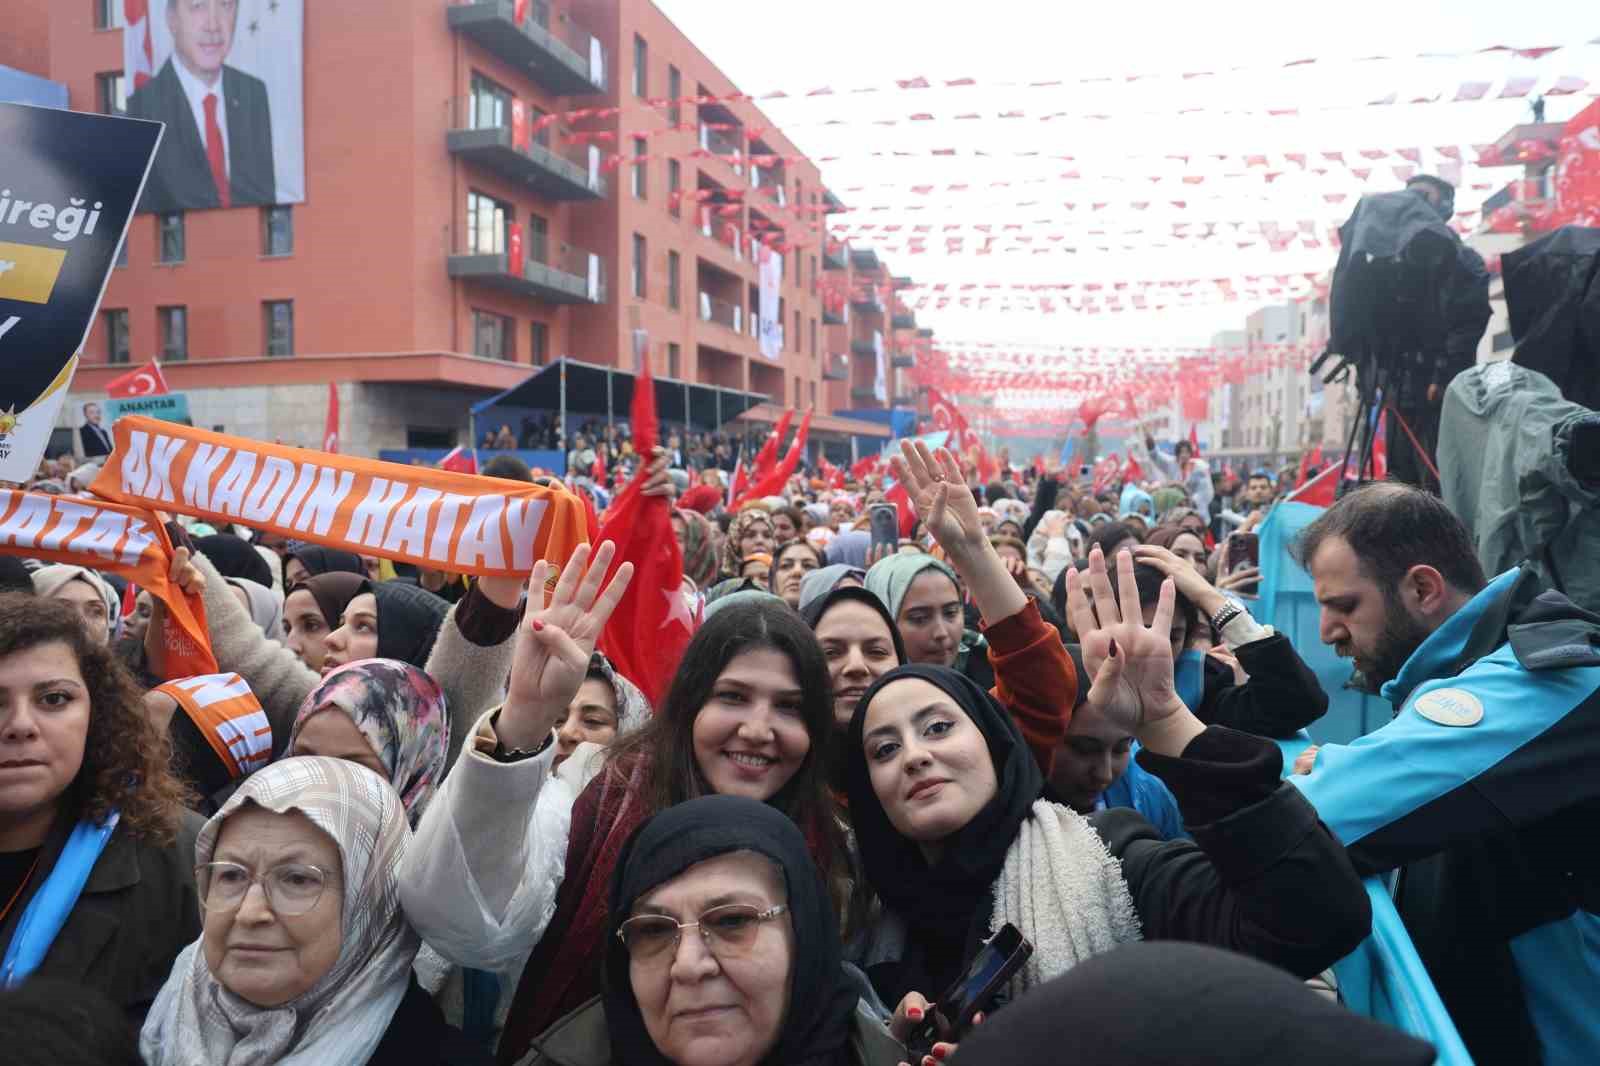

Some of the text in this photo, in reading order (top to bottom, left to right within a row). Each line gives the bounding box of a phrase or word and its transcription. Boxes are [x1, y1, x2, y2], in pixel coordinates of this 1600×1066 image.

[119, 399, 176, 412] ANAHTAR
[0, 489, 156, 567] ATAY
[121, 430, 549, 571] AK KADIN HATAY
